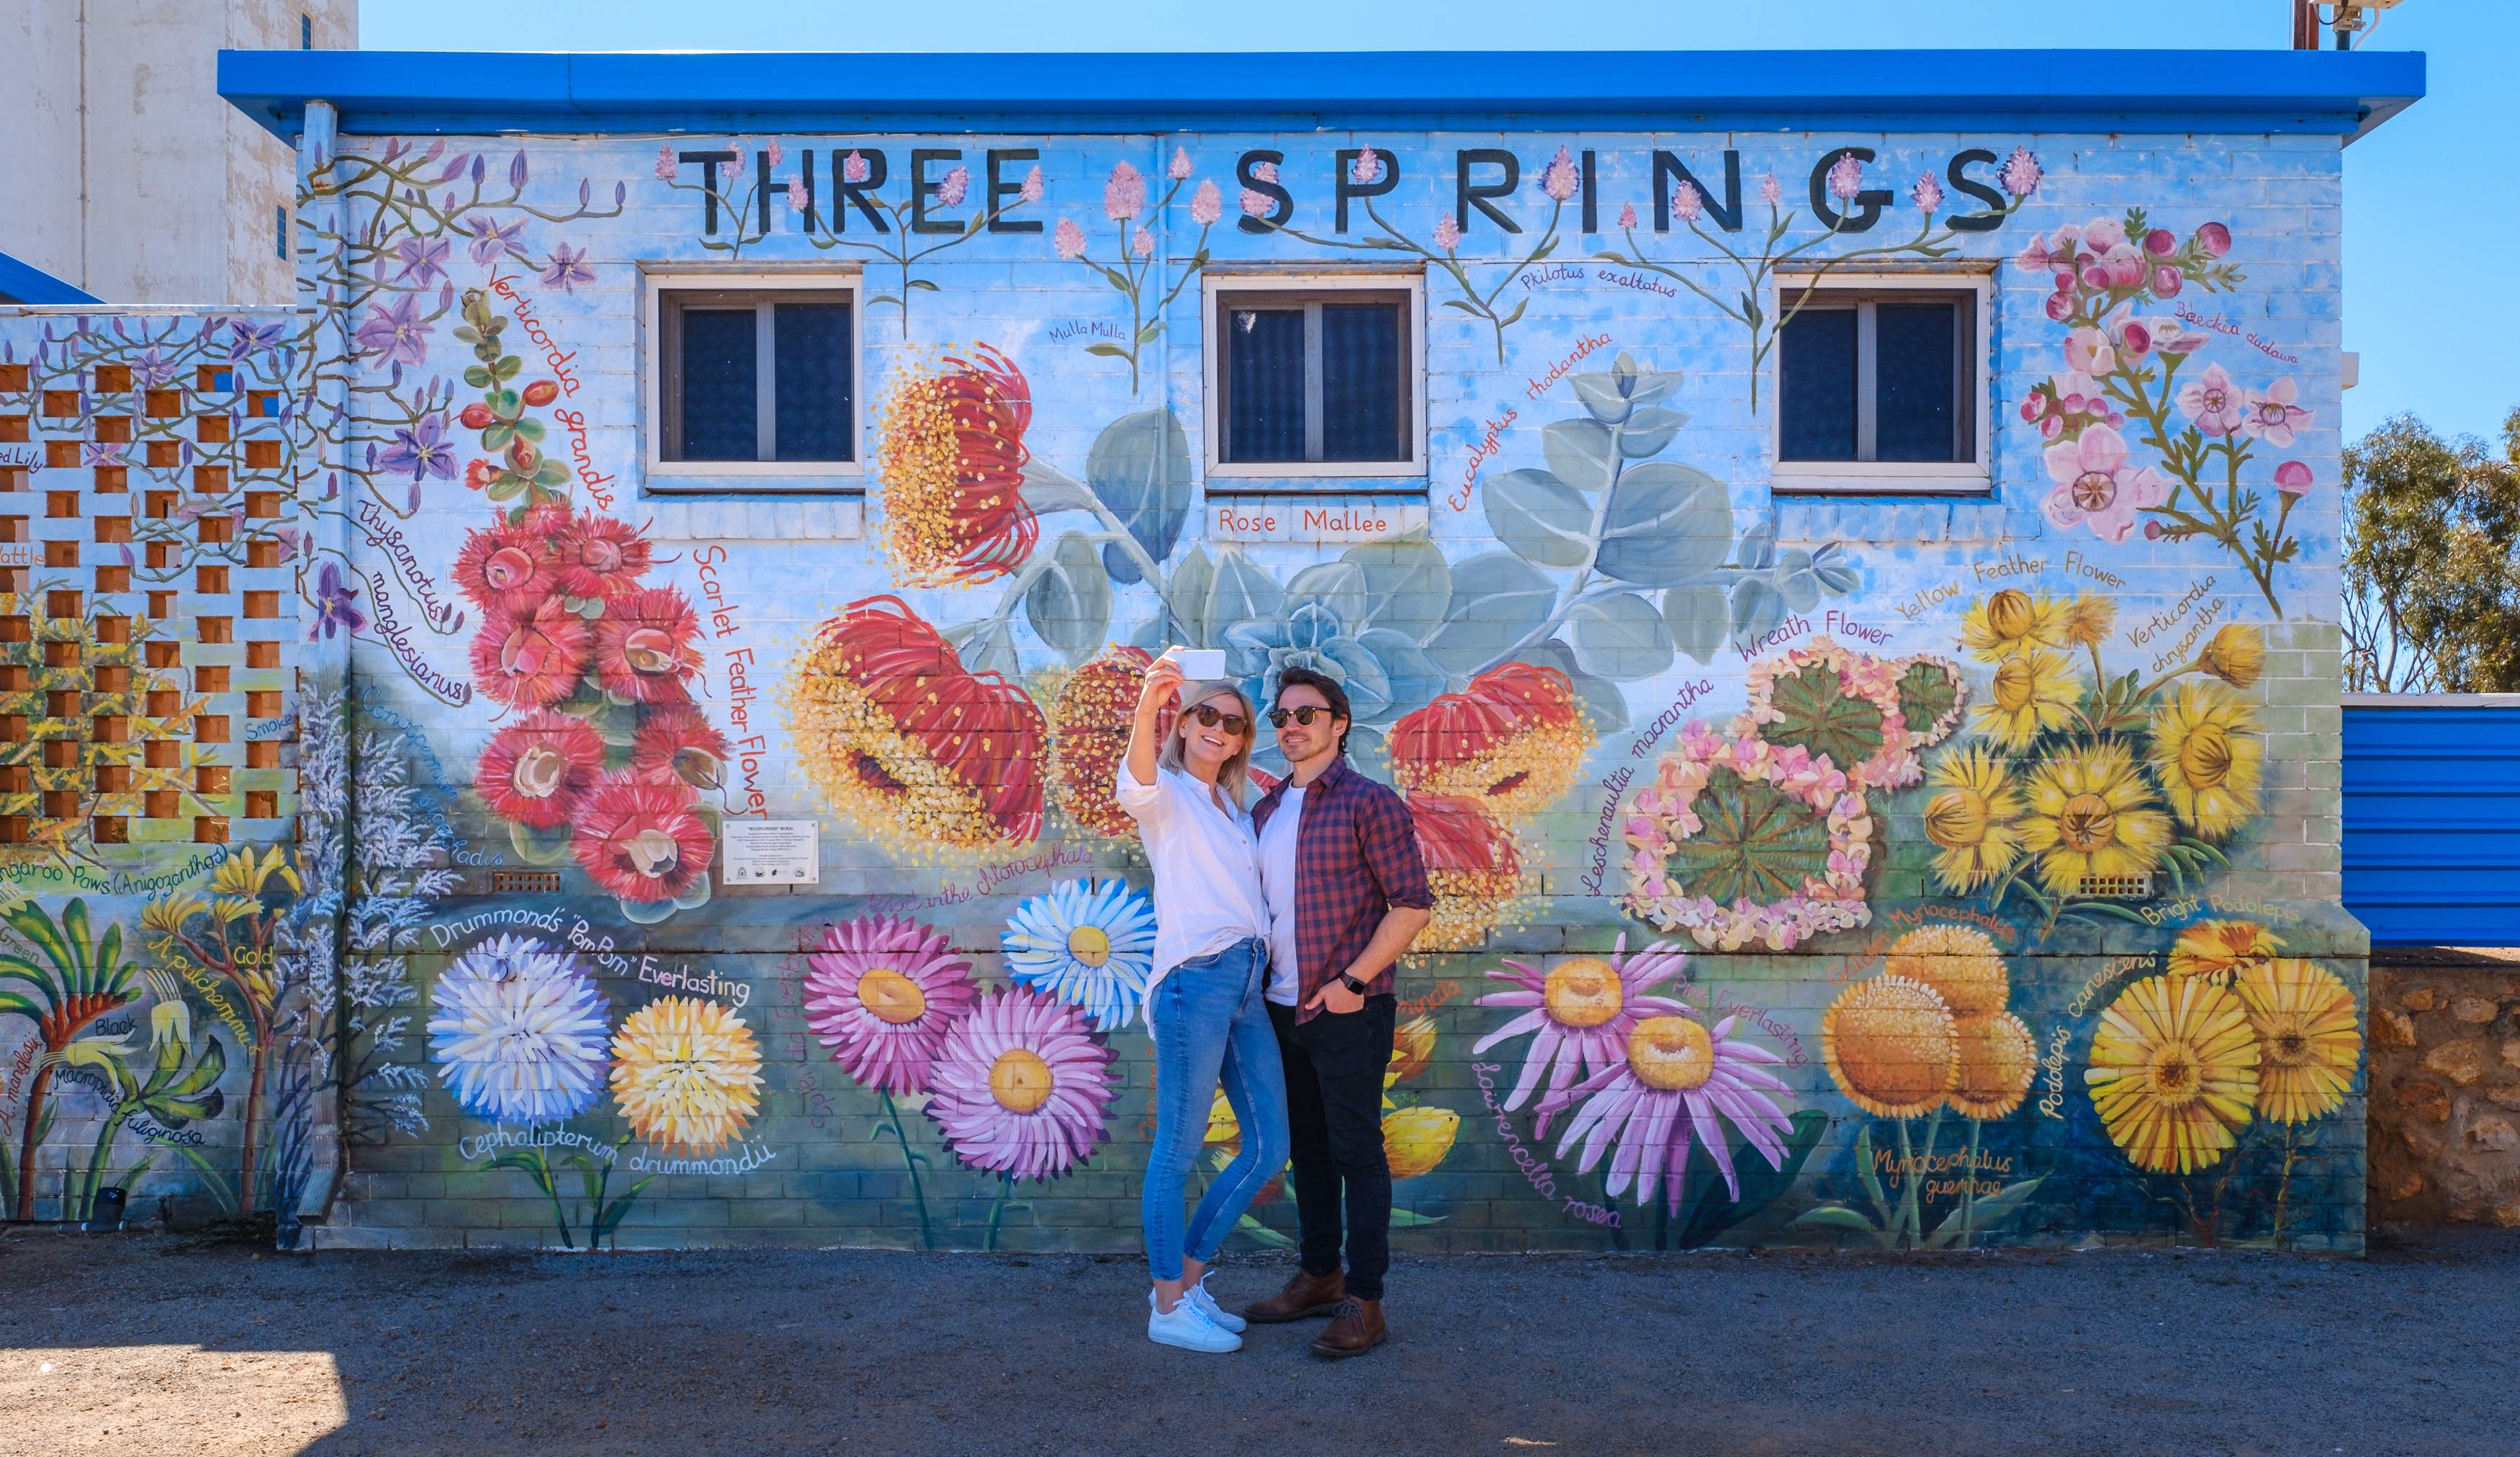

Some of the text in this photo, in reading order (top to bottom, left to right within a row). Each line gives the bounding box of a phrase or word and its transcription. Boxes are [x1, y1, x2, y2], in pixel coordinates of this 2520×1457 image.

[679, 147, 2006, 236] THREE SPRINGS
[1521, 264, 1676, 297] Ptilotus exaltatus
[1048, 320, 1126, 343] Mulla Mulla
[489, 264, 615, 511] Verticordia grandis
[1447, 332, 1613, 512] Eucalyptus rhodantha
[15, 447, 42, 474] Lily
[1219, 509, 1387, 532] Rose Mallee
[357, 499, 462, 699] Thysanotus manglesianus
[1894, 550, 2125, 622] Yellow Feather Flower
[1734, 610, 1894, 662] Wreath Flower
[2125, 574, 2225, 674] Verticordia chrysantha
[693, 544, 768, 819] Scarlet Feather Flower
[245, 714, 292, 740] Smoke
[1632, 679, 1714, 759] macrantha
[72, 866, 110, 894] Paws
[976, 843, 1094, 895] chlorocephala
[1889, 903, 2015, 942] Myriocephalus
[2140, 893, 2300, 925] Bright Podolepis
[0, 926, 40, 964] Green
[148, 935, 174, 959] A
[233, 946, 273, 965] Gold
[638, 955, 750, 1005] Everlasting
[95, 1014, 135, 1036] Black
[1716, 989, 1809, 1070] Everlasting
[2038, 950, 2158, 1119] Podolepis canescens
[113, 1109, 206, 1144] fuliginosa
[630, 1136, 776, 1175] drummondii
[1562, 1196, 1621, 1228] rosea
